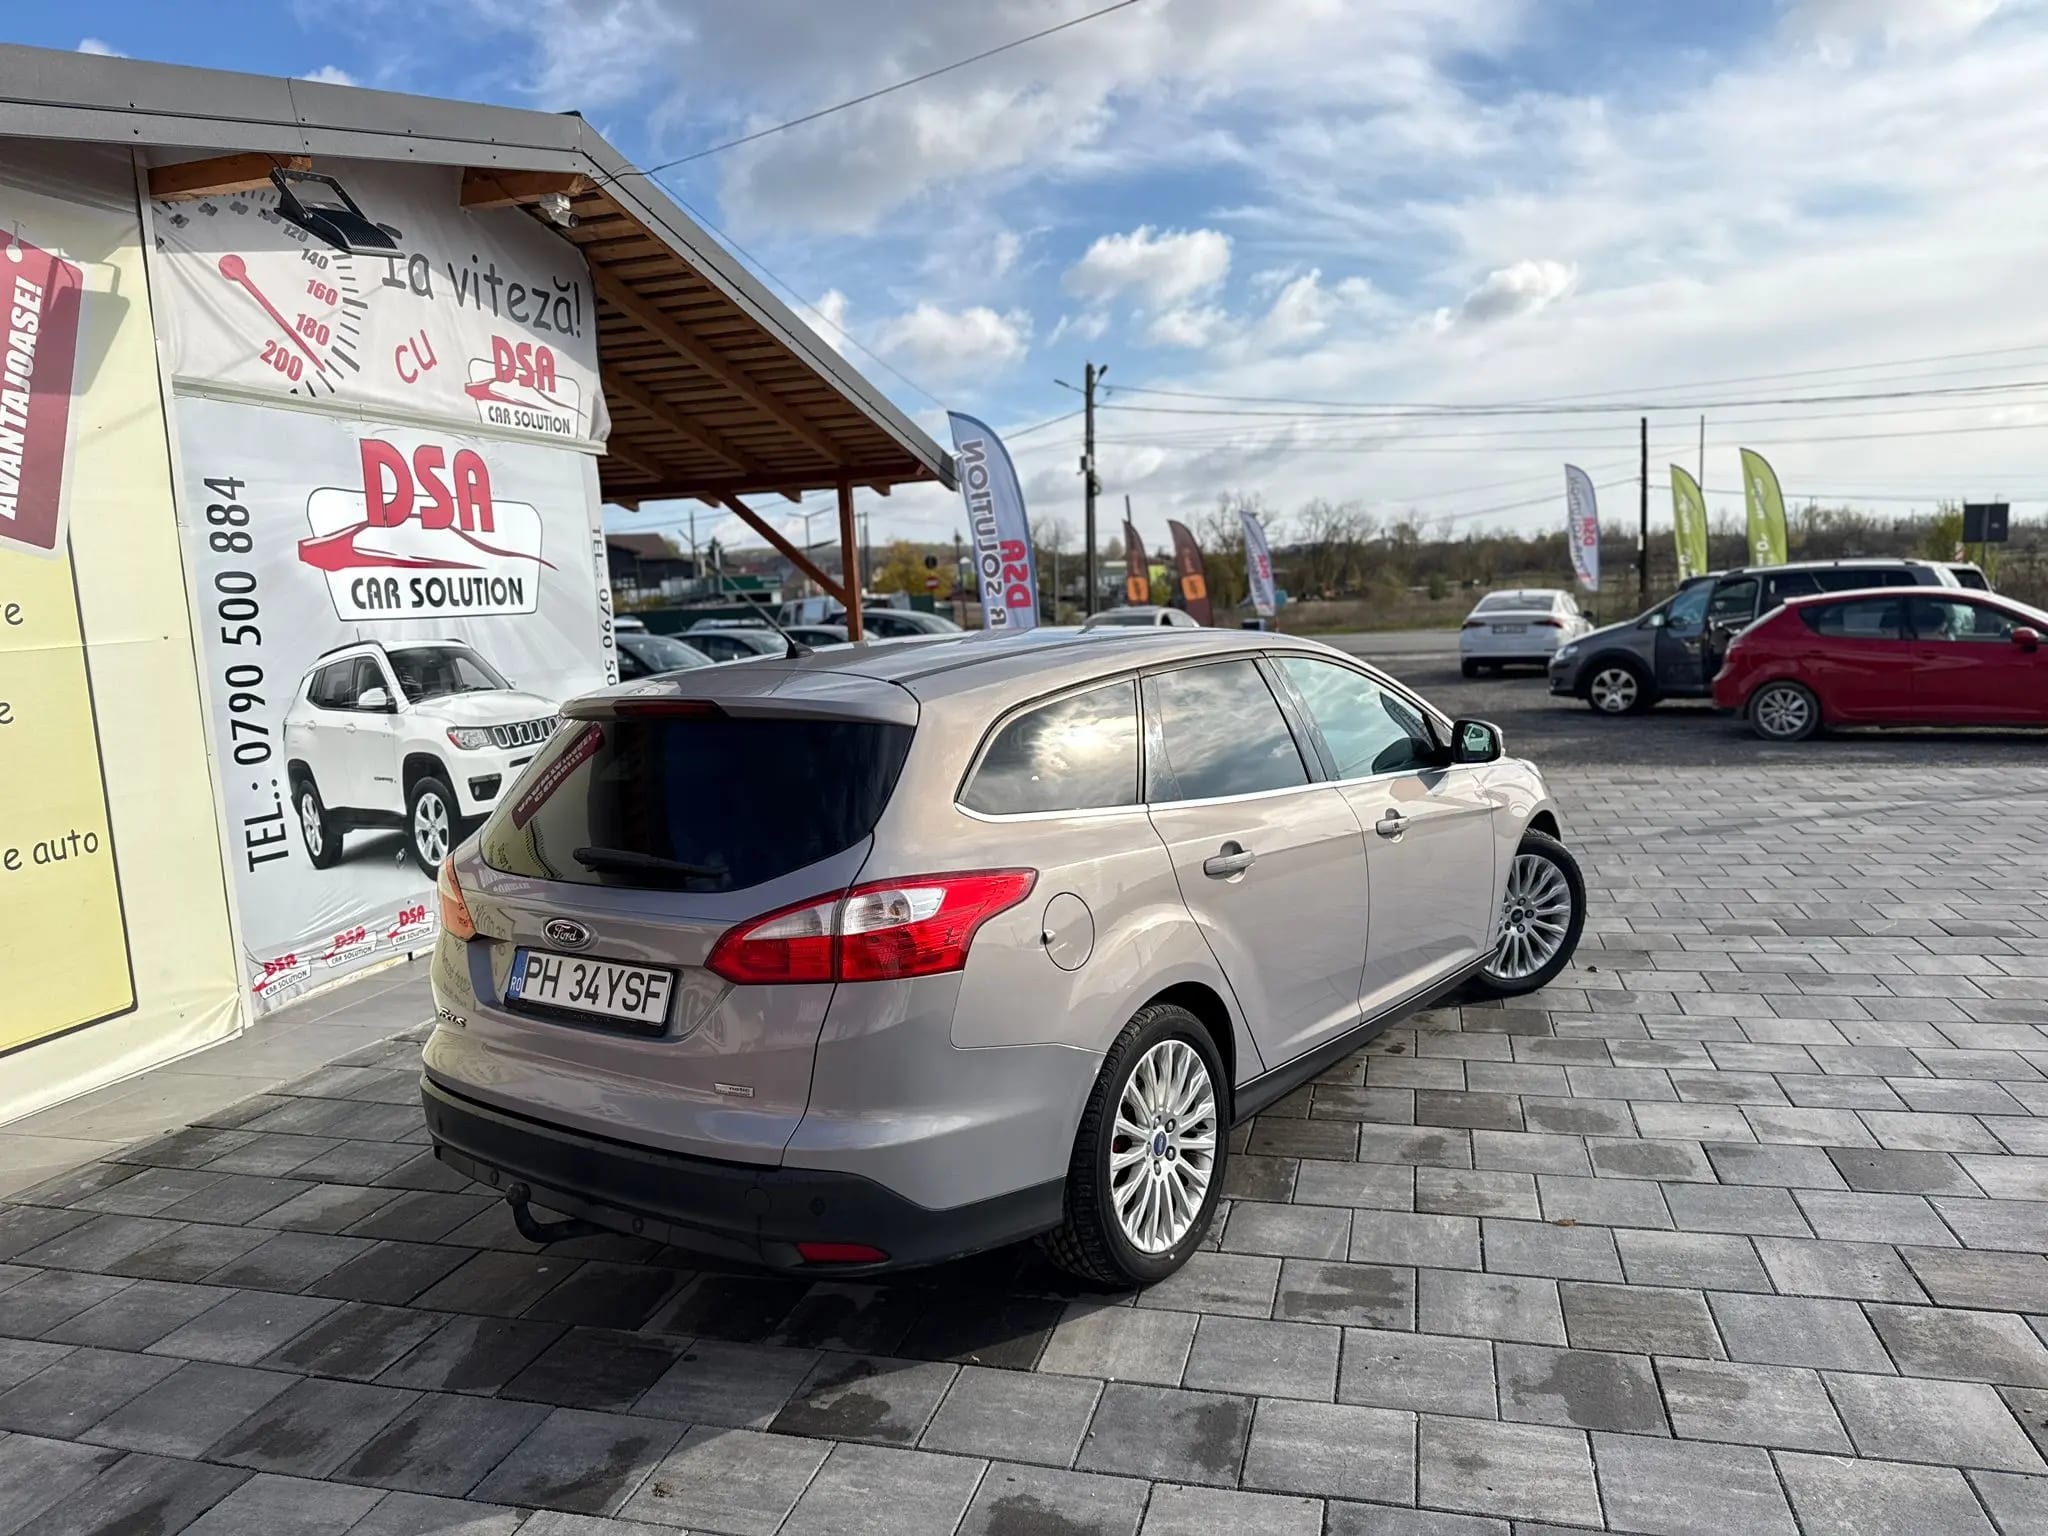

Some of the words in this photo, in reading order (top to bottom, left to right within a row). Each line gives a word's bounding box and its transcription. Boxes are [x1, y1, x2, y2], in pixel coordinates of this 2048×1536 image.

[283, 222, 310, 242] 120
[301, 248, 329, 270] 140
[307, 279, 338, 306] 160
[448, 254, 581, 338] viteză!
[295, 313, 330, 346] 180
[259, 340, 304, 382] 200
[395, 329, 438, 384] cu
[491, 335, 556, 393] DSA
[0, 275, 43, 521] AVANTAJOASE!
[488, 406, 511, 425] CAR
[514, 410, 571, 435] SOLUTION
[359, 438, 495, 533] DSA
[203, 476, 253, 553] 884
[214, 571, 262, 646] 500
[351, 577, 401, 610] CAR
[409, 577, 523, 608] SOLUTION
[599, 588, 614, 649] 0790
[225, 664, 272, 766] 0790
[244, 778, 289, 873] TEL.:
[32, 829, 99, 865] auto
[399, 905, 425, 927] DSA
[335, 926, 366, 948] DSA
[395, 934, 407, 944] CAR
[407, 927, 430, 940] SOLUTION
[552, 924, 577, 942] Ford
[264, 953, 298, 976] DSA
[331, 955, 343, 964] CAR
[343, 946, 372, 960] SOLUTION
[265, 982, 278, 995] CAR
[278, 970, 308, 989] SOLUTION
[509, 976, 521, 992] RO
[522, 956, 562, 998] PH
